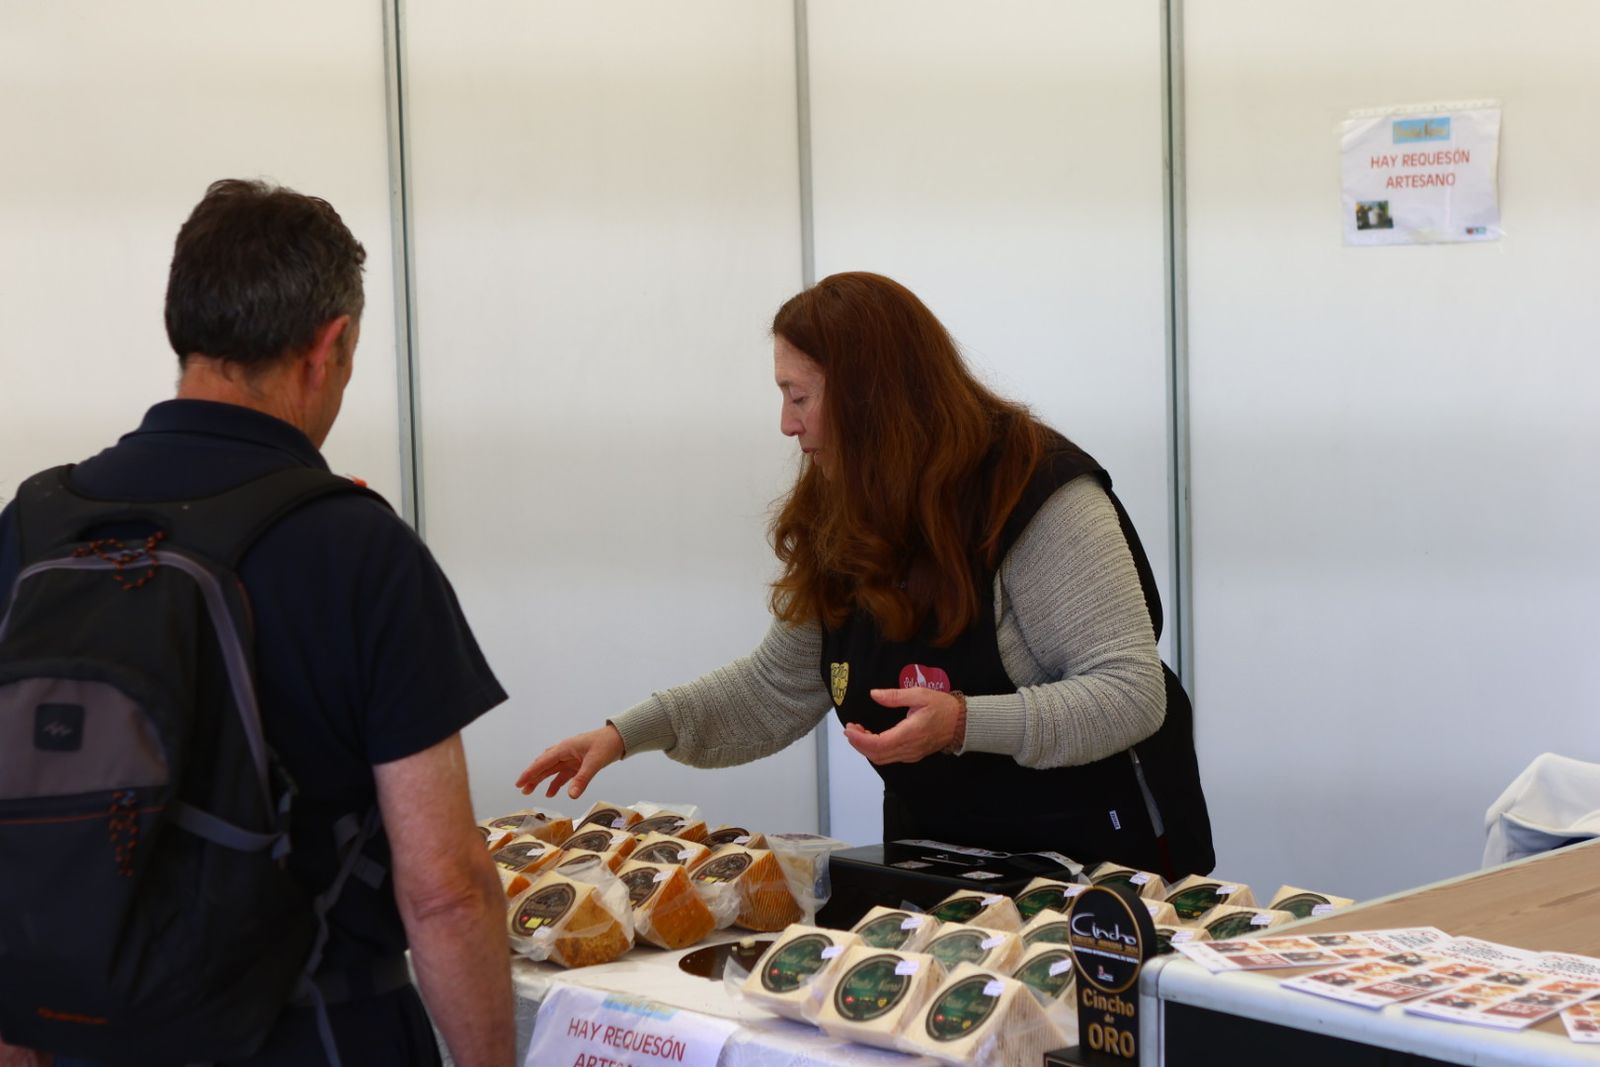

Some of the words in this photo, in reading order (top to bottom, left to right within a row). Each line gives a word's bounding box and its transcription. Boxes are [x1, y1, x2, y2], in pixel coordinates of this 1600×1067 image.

[1370, 155, 1397, 168] HAY
[1402, 148, 1470, 167] REQUESÓN
[1385, 173, 1456, 189] ARTESANO
[1071, 912, 1137, 945] Cincho
[1082, 987, 1135, 1018] Cincho
[567, 1018, 602, 1041] HAY
[603, 1025, 686, 1062] REQUESÓN
[1088, 1023, 1135, 1059] ORO
